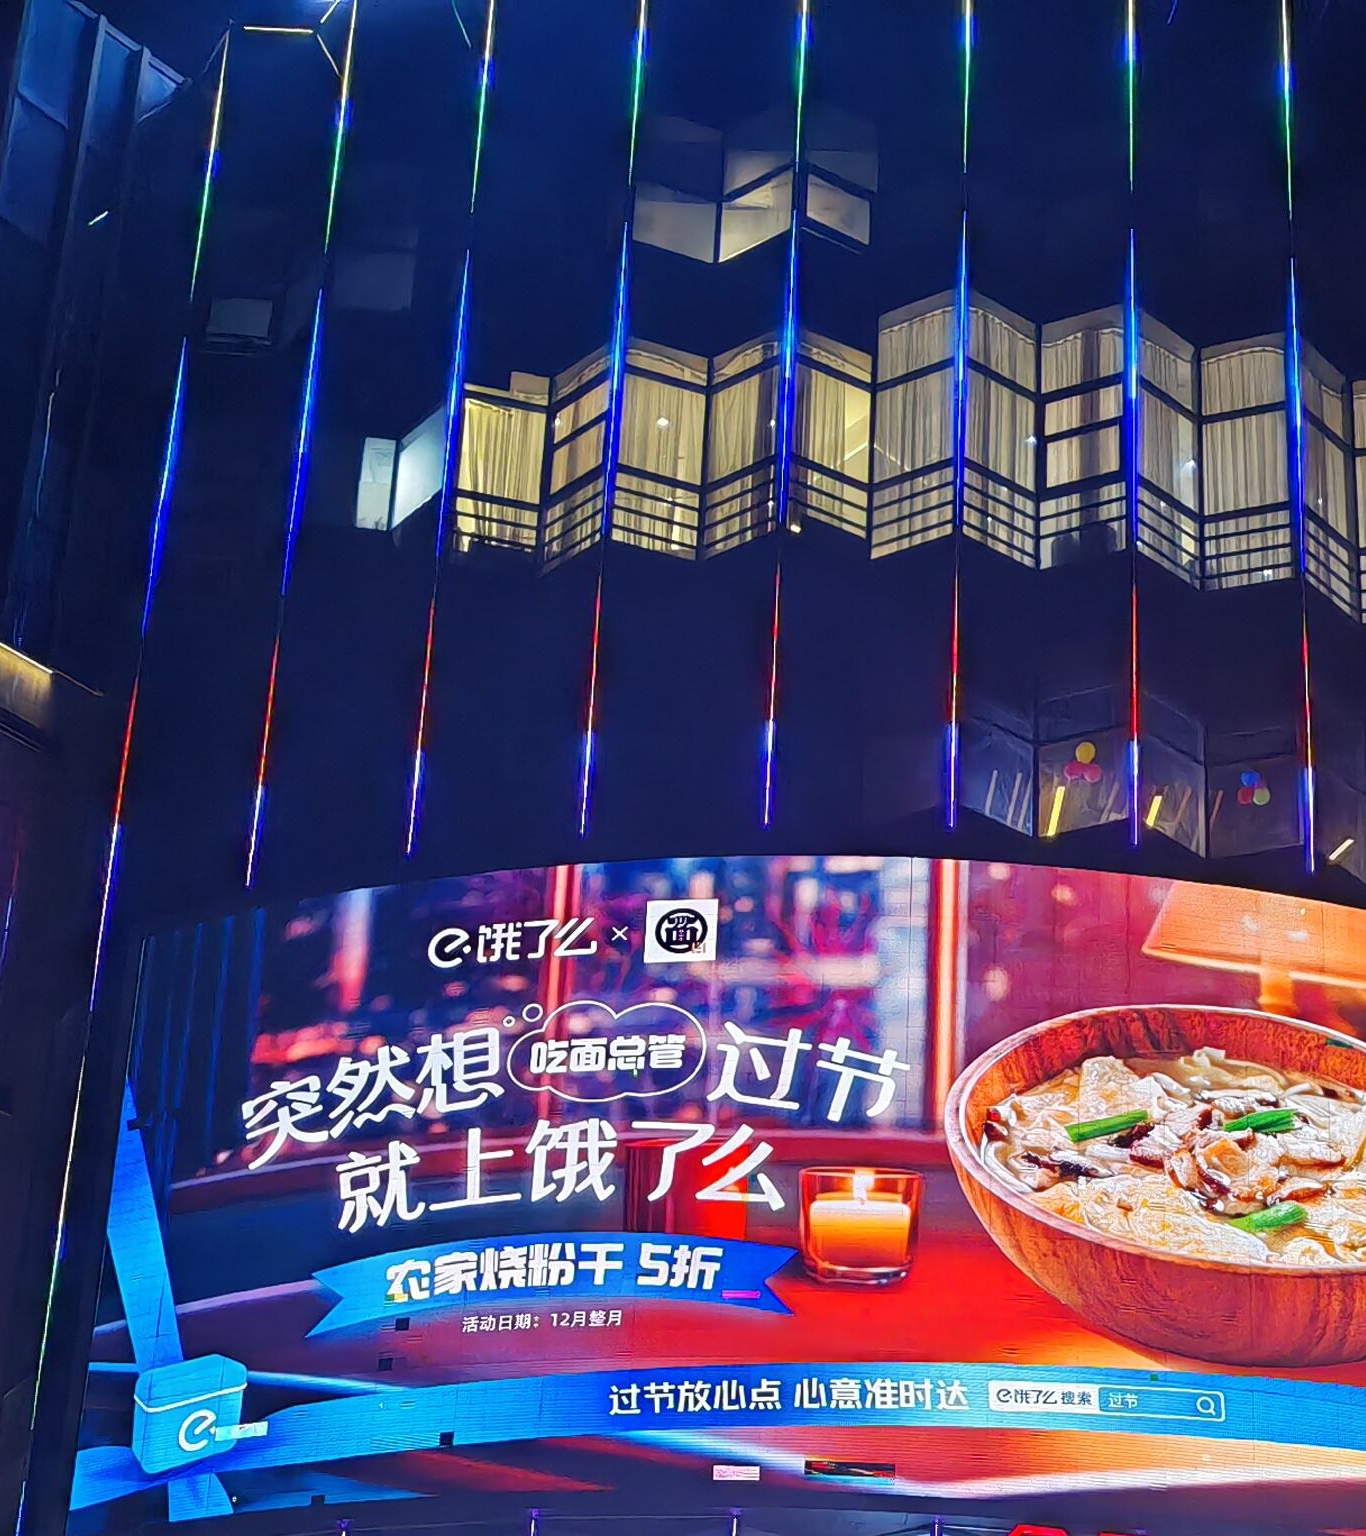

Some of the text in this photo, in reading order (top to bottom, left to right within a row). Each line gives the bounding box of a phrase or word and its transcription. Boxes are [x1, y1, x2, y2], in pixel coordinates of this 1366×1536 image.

[242, 1021, 911, 1169] 突然想 吃面总管 过节
[335, 1117, 785, 1233] 就上饿了么
[386, 1243, 723, 1304] 农家烧粉干 5折
[609, 1380, 782, 1416] 过节放心点
[793, 1379, 969, 1412] 心意准时达
